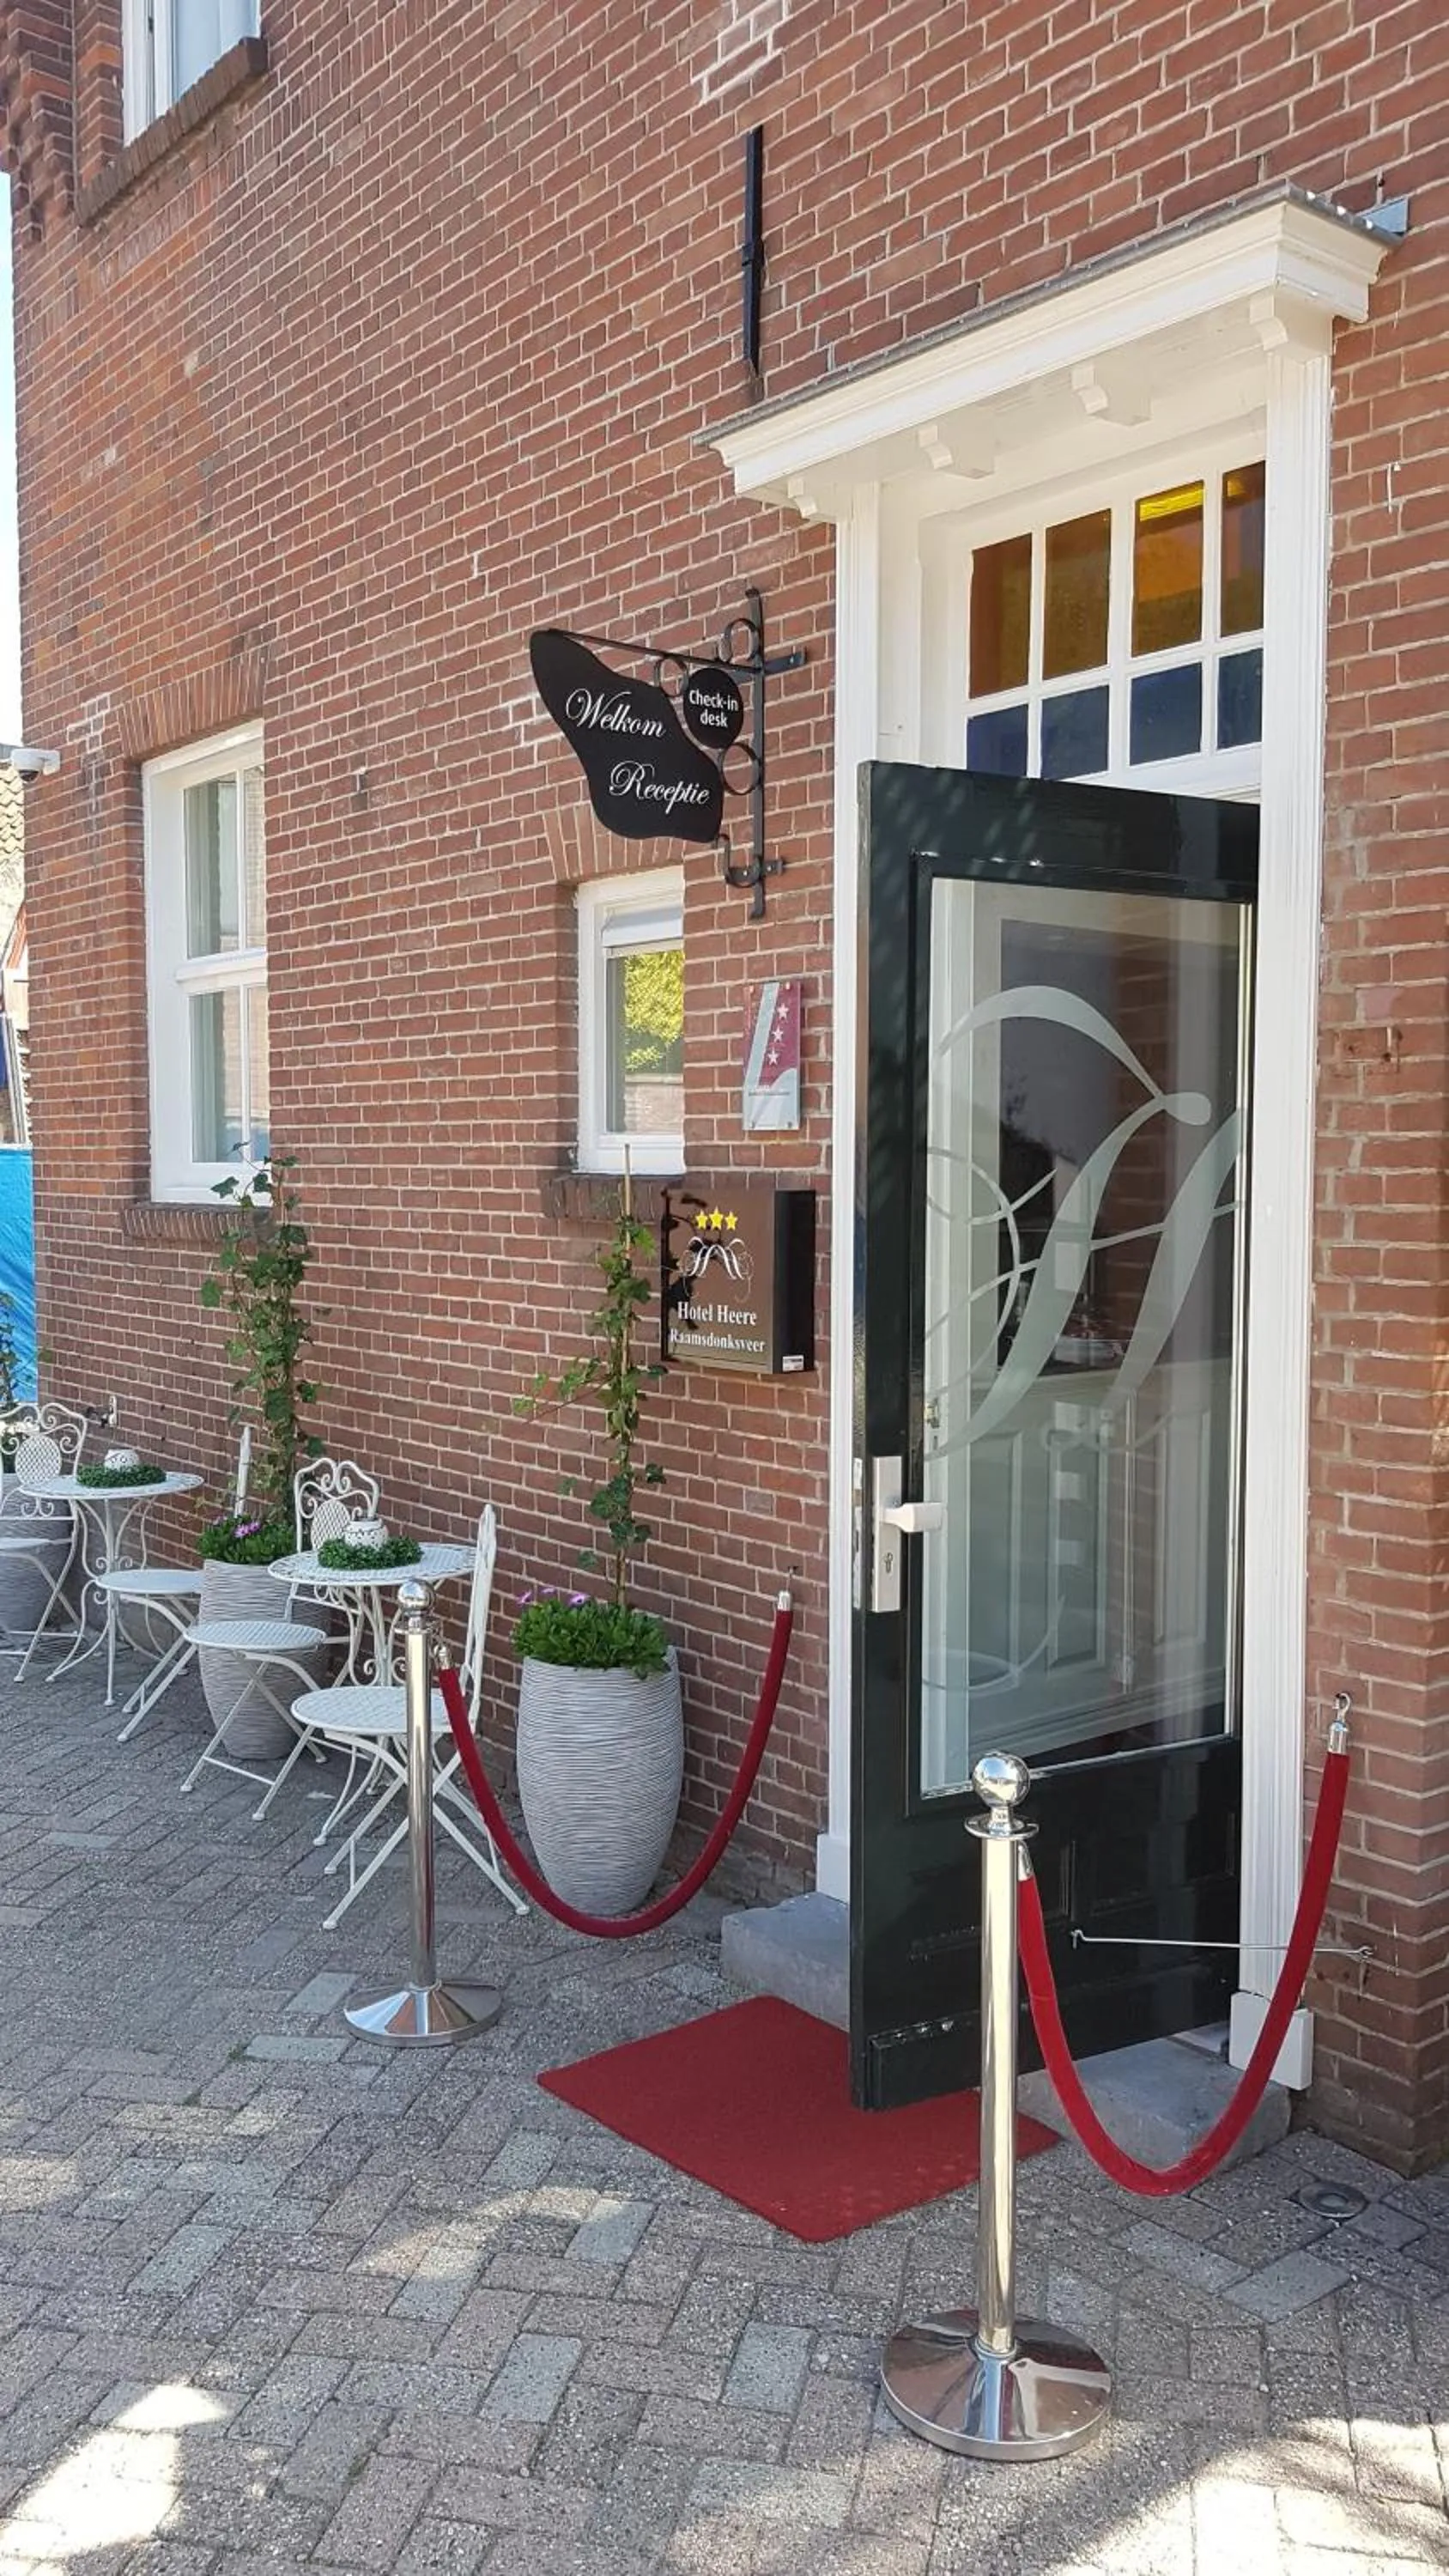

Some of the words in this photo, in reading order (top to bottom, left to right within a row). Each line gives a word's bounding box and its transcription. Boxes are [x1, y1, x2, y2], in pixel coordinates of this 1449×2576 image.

[688, 689, 738, 712] Check-in
[566, 689, 665, 738] Welkom
[700, 711, 728, 728] desk
[609, 761, 710, 815] Receptie
[677, 1301, 713, 1322] Hotel
[717, 1304, 757, 1326] Heere
[670, 1328, 766, 1352] Raamsdonksveer
